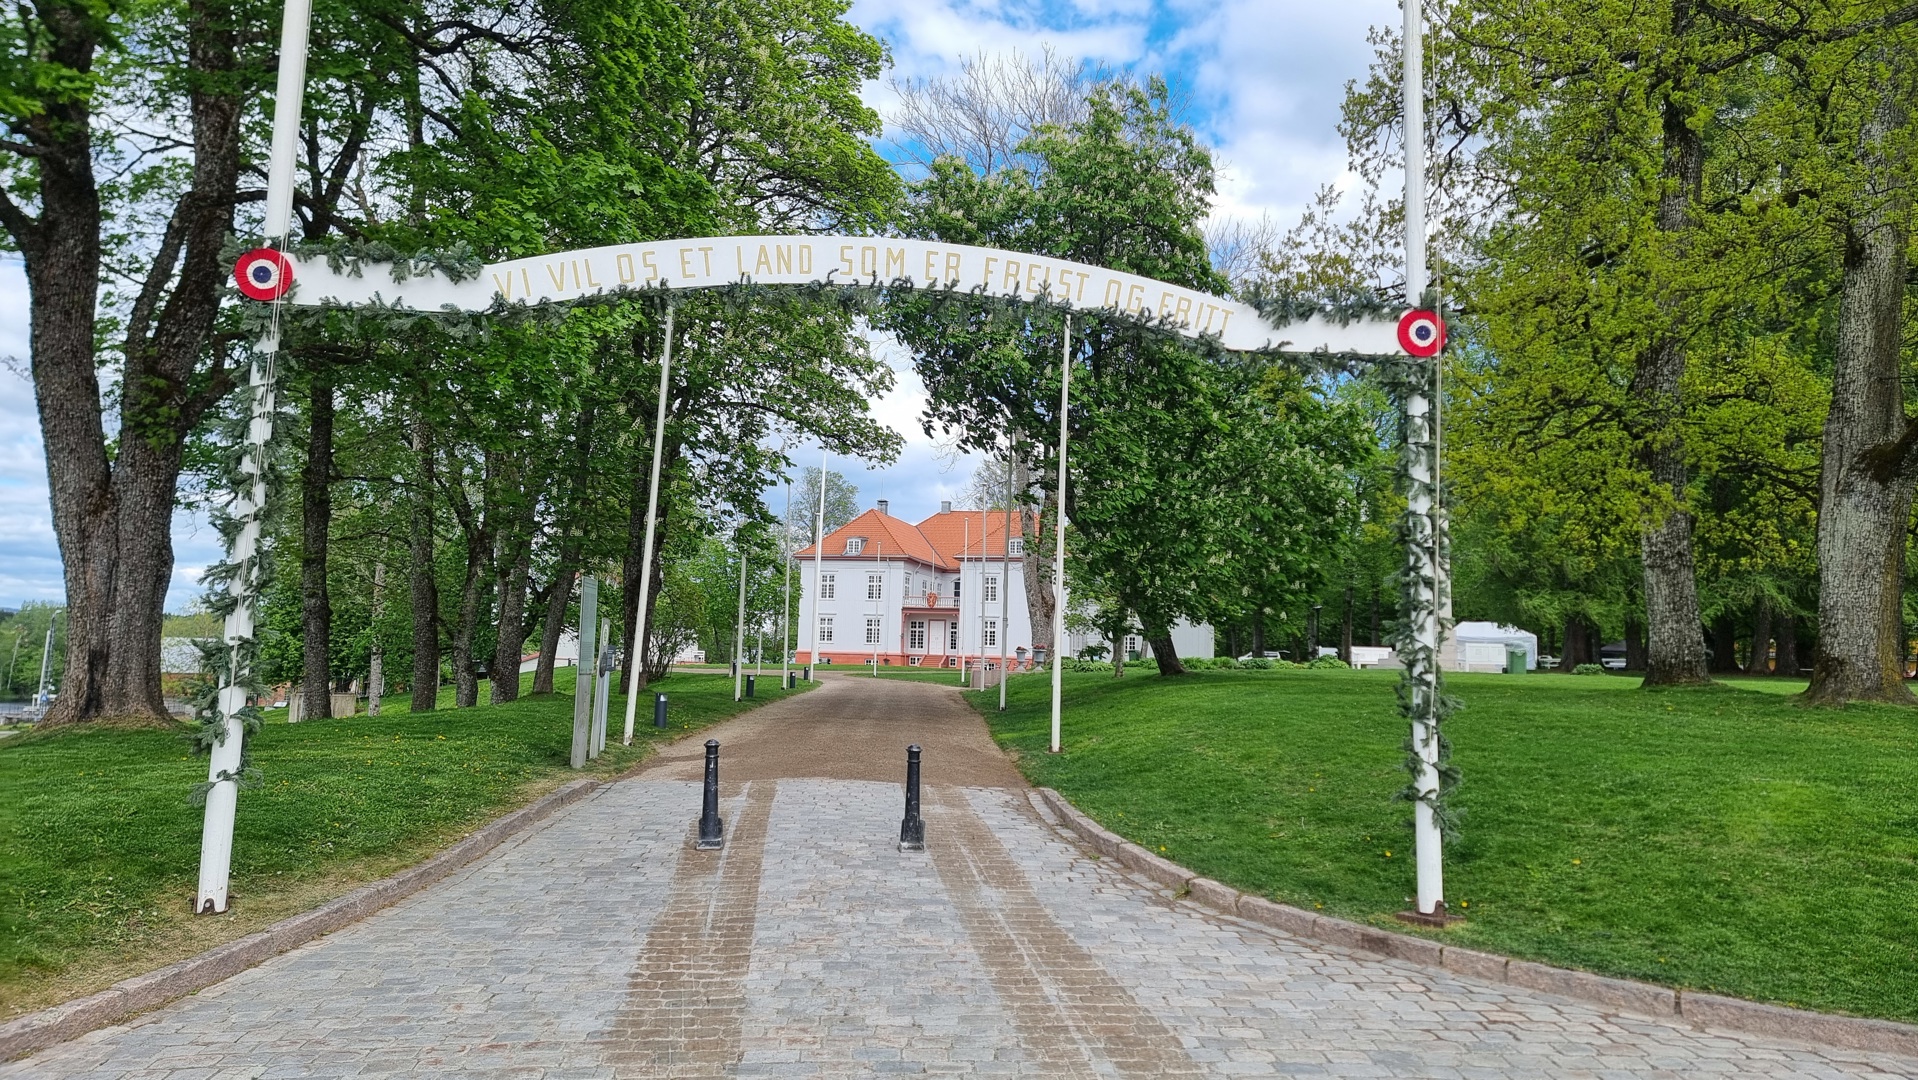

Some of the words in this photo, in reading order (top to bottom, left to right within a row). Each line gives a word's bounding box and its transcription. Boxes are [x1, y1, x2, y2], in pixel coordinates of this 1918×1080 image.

[492, 267, 531, 300] VI
[546, 259, 602, 292] VIL
[617, 250, 658, 284] OS
[680, 246, 714, 279] ET
[737, 244, 812, 276] LAND
[839, 245, 905, 278] SOM
[925, 250, 961, 282] ER
[1103, 279, 1145, 314] OG
[1156, 291, 1235, 334] FRITT
